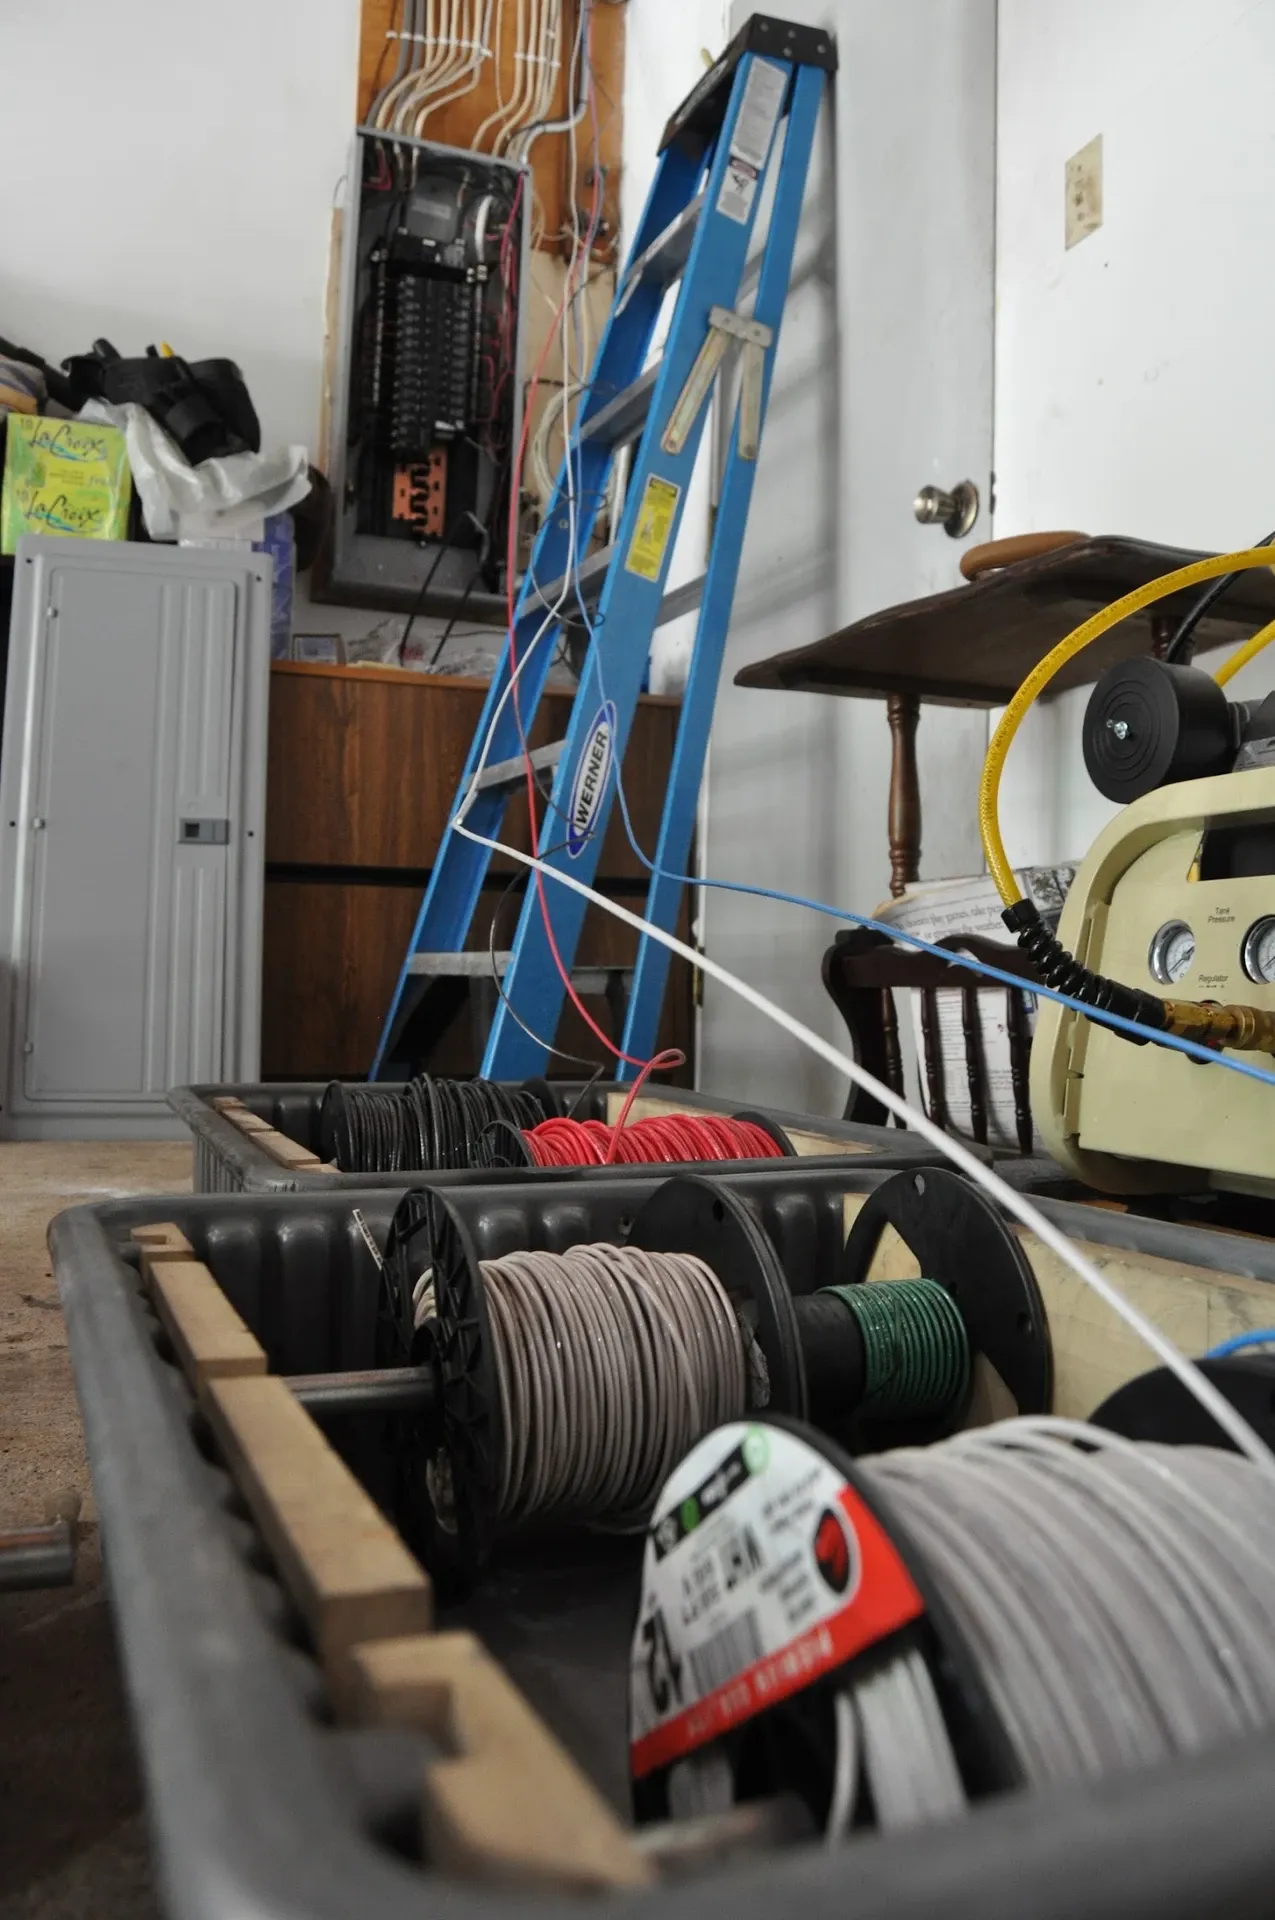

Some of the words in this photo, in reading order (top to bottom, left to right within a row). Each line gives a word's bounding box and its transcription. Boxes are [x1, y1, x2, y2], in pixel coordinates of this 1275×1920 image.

[575, 730, 609, 825] WERNER
[1208, 915, 1235, 923] Pressure
[1198, 974, 1228, 983] Regulator
